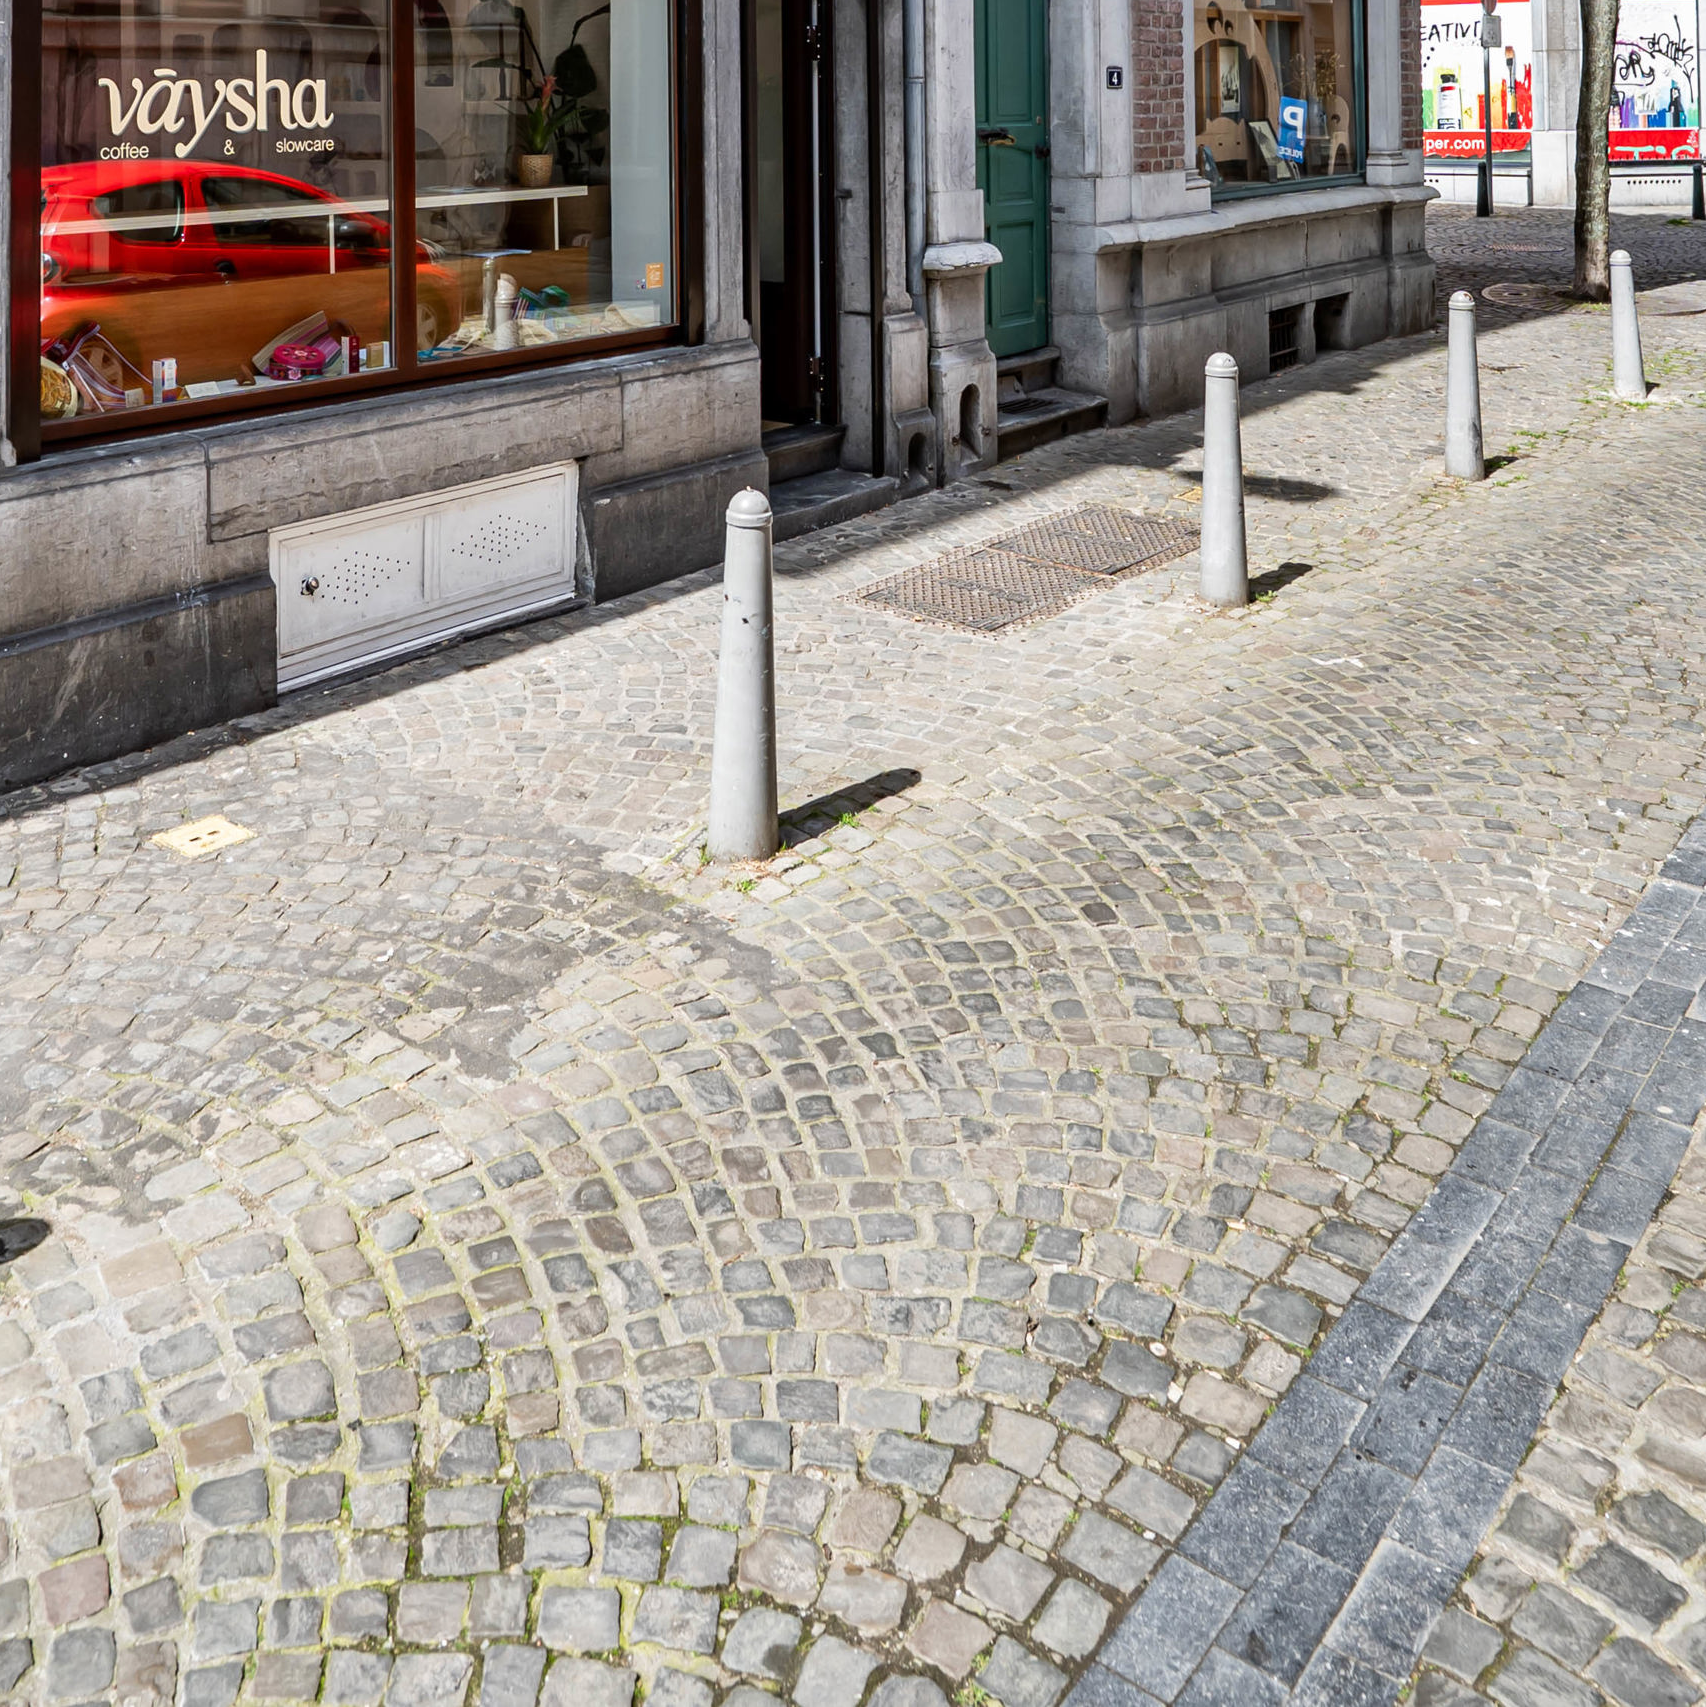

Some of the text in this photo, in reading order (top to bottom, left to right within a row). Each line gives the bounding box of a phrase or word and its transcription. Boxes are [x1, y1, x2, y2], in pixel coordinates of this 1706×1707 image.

[1111, 72, 1118, 85] 4
[100, 137, 335, 160] coffee & slowcare
